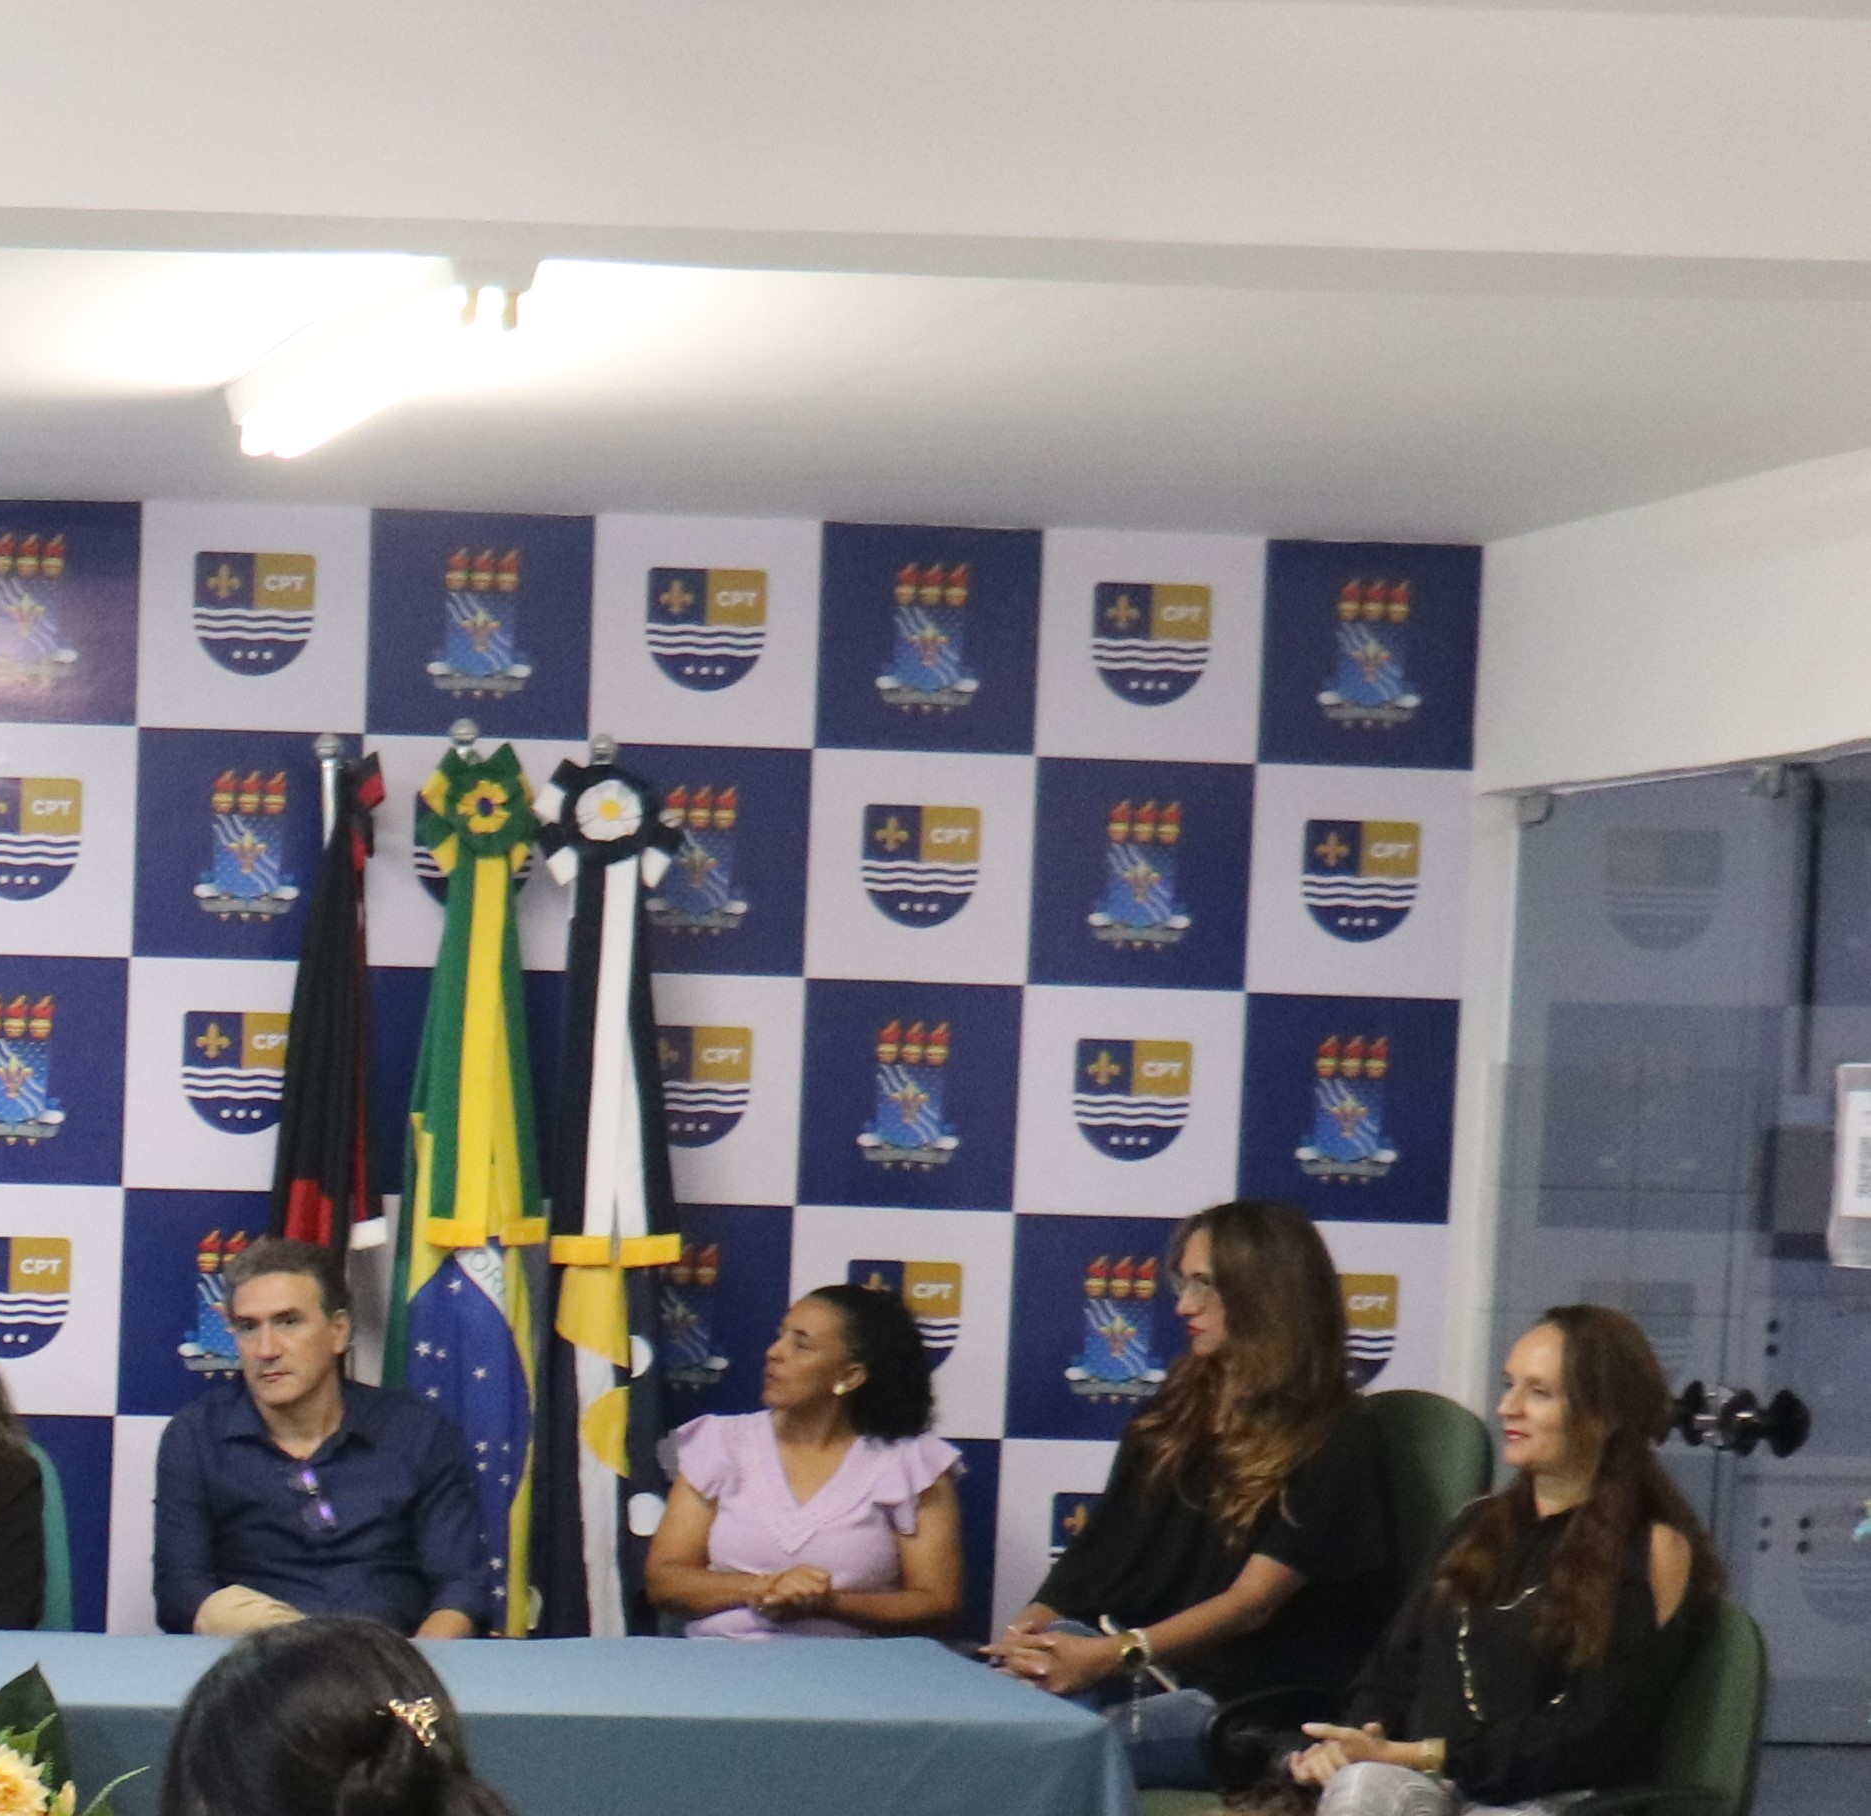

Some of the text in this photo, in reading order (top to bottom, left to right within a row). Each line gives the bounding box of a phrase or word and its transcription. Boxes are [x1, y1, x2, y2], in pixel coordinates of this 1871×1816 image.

[264, 575, 306, 590] CPT
[716, 590, 758, 606] CPT
[31, 798, 72, 815] CPT
[930, 827, 972, 843] CPT
[1370, 842, 1413, 858] CPT
[703, 1047, 744, 1063] CPT
[1141, 1061, 1183, 1077] CPT
[20, 1257, 62, 1274] CPT
[912, 1282, 953, 1298] CPT
